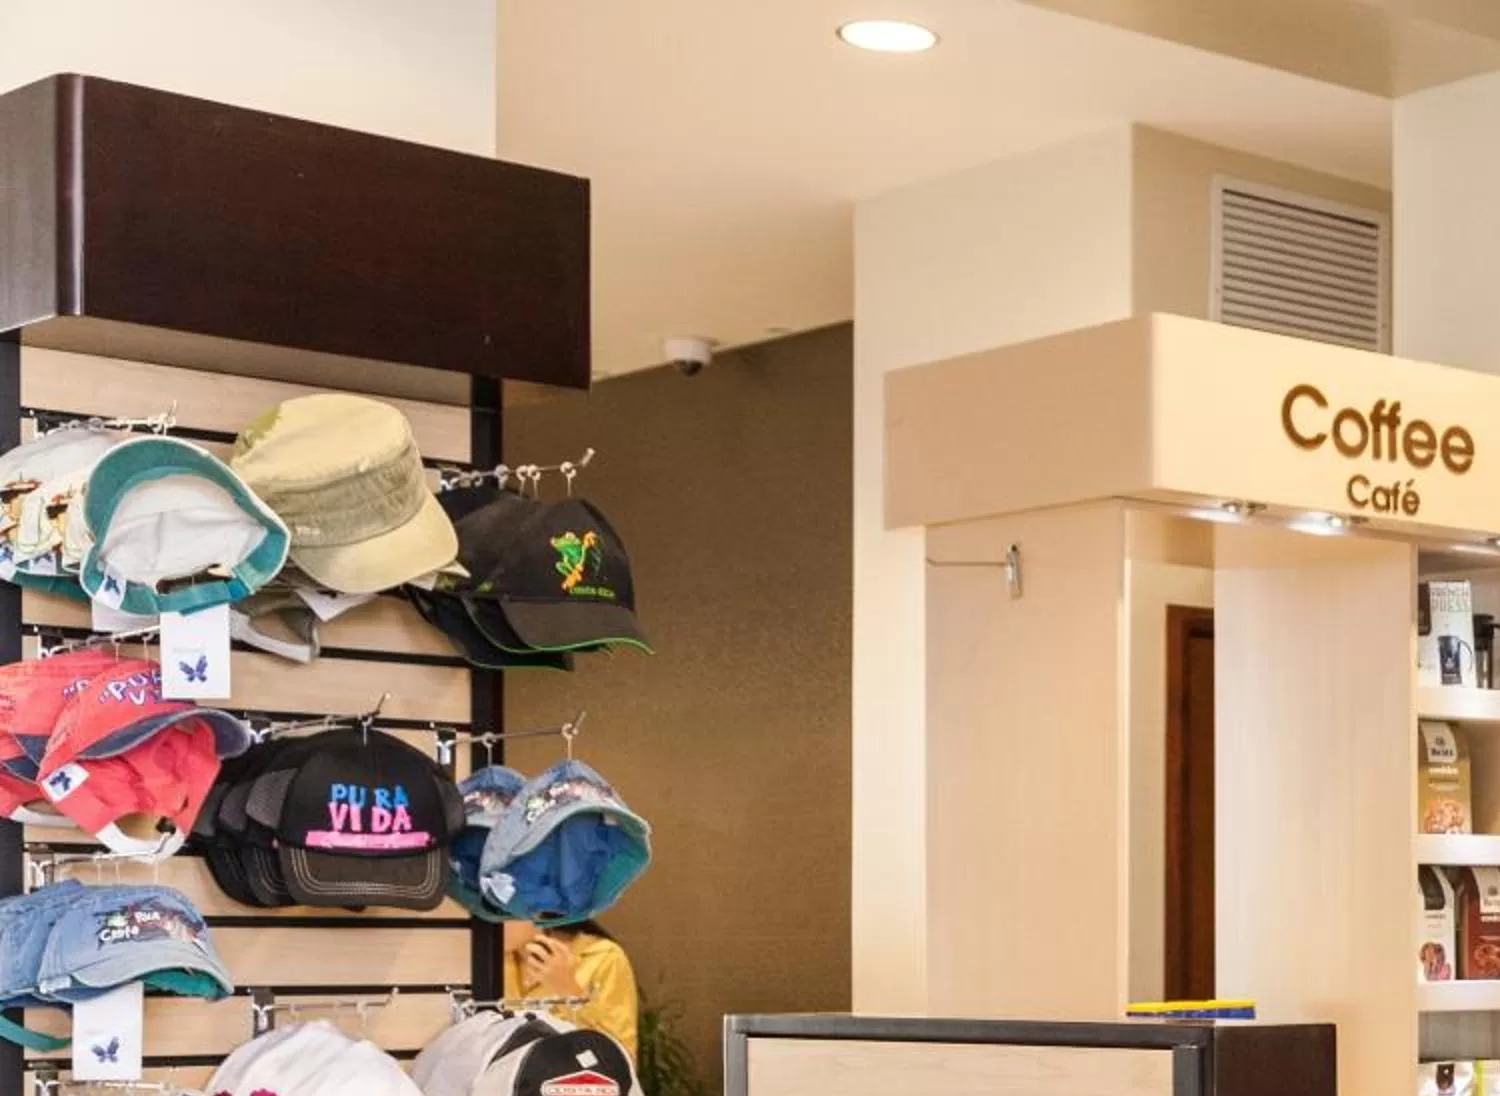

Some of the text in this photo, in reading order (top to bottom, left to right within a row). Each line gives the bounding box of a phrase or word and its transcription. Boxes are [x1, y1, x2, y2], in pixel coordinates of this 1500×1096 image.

[1281, 384, 1475, 475] Coffee
[1346, 473, 1420, 516] Café
[330, 783, 408, 807] PURA
[328, 802, 411, 832] VIDA
